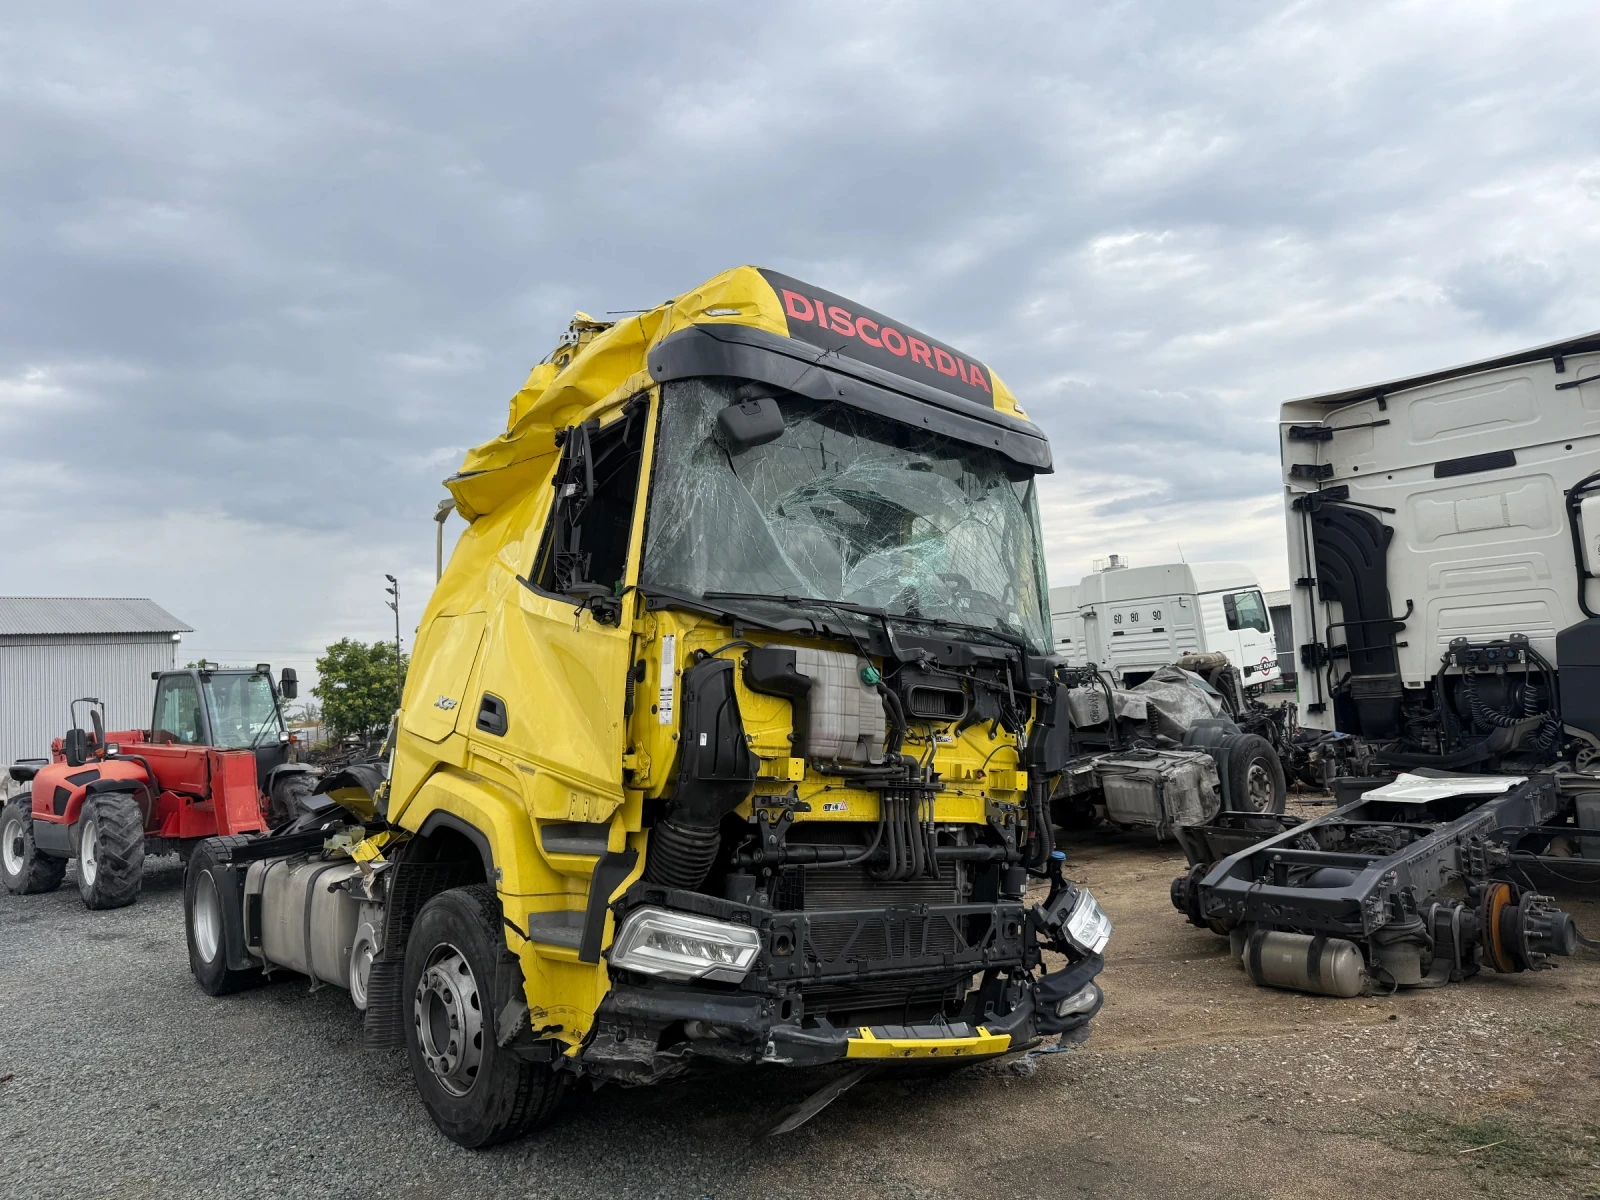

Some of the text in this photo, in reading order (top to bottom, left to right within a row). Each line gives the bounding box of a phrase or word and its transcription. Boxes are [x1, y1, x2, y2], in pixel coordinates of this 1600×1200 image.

[781, 288, 992, 394] DISCORDIA
[1113, 610, 1162, 624] 60 80 90
